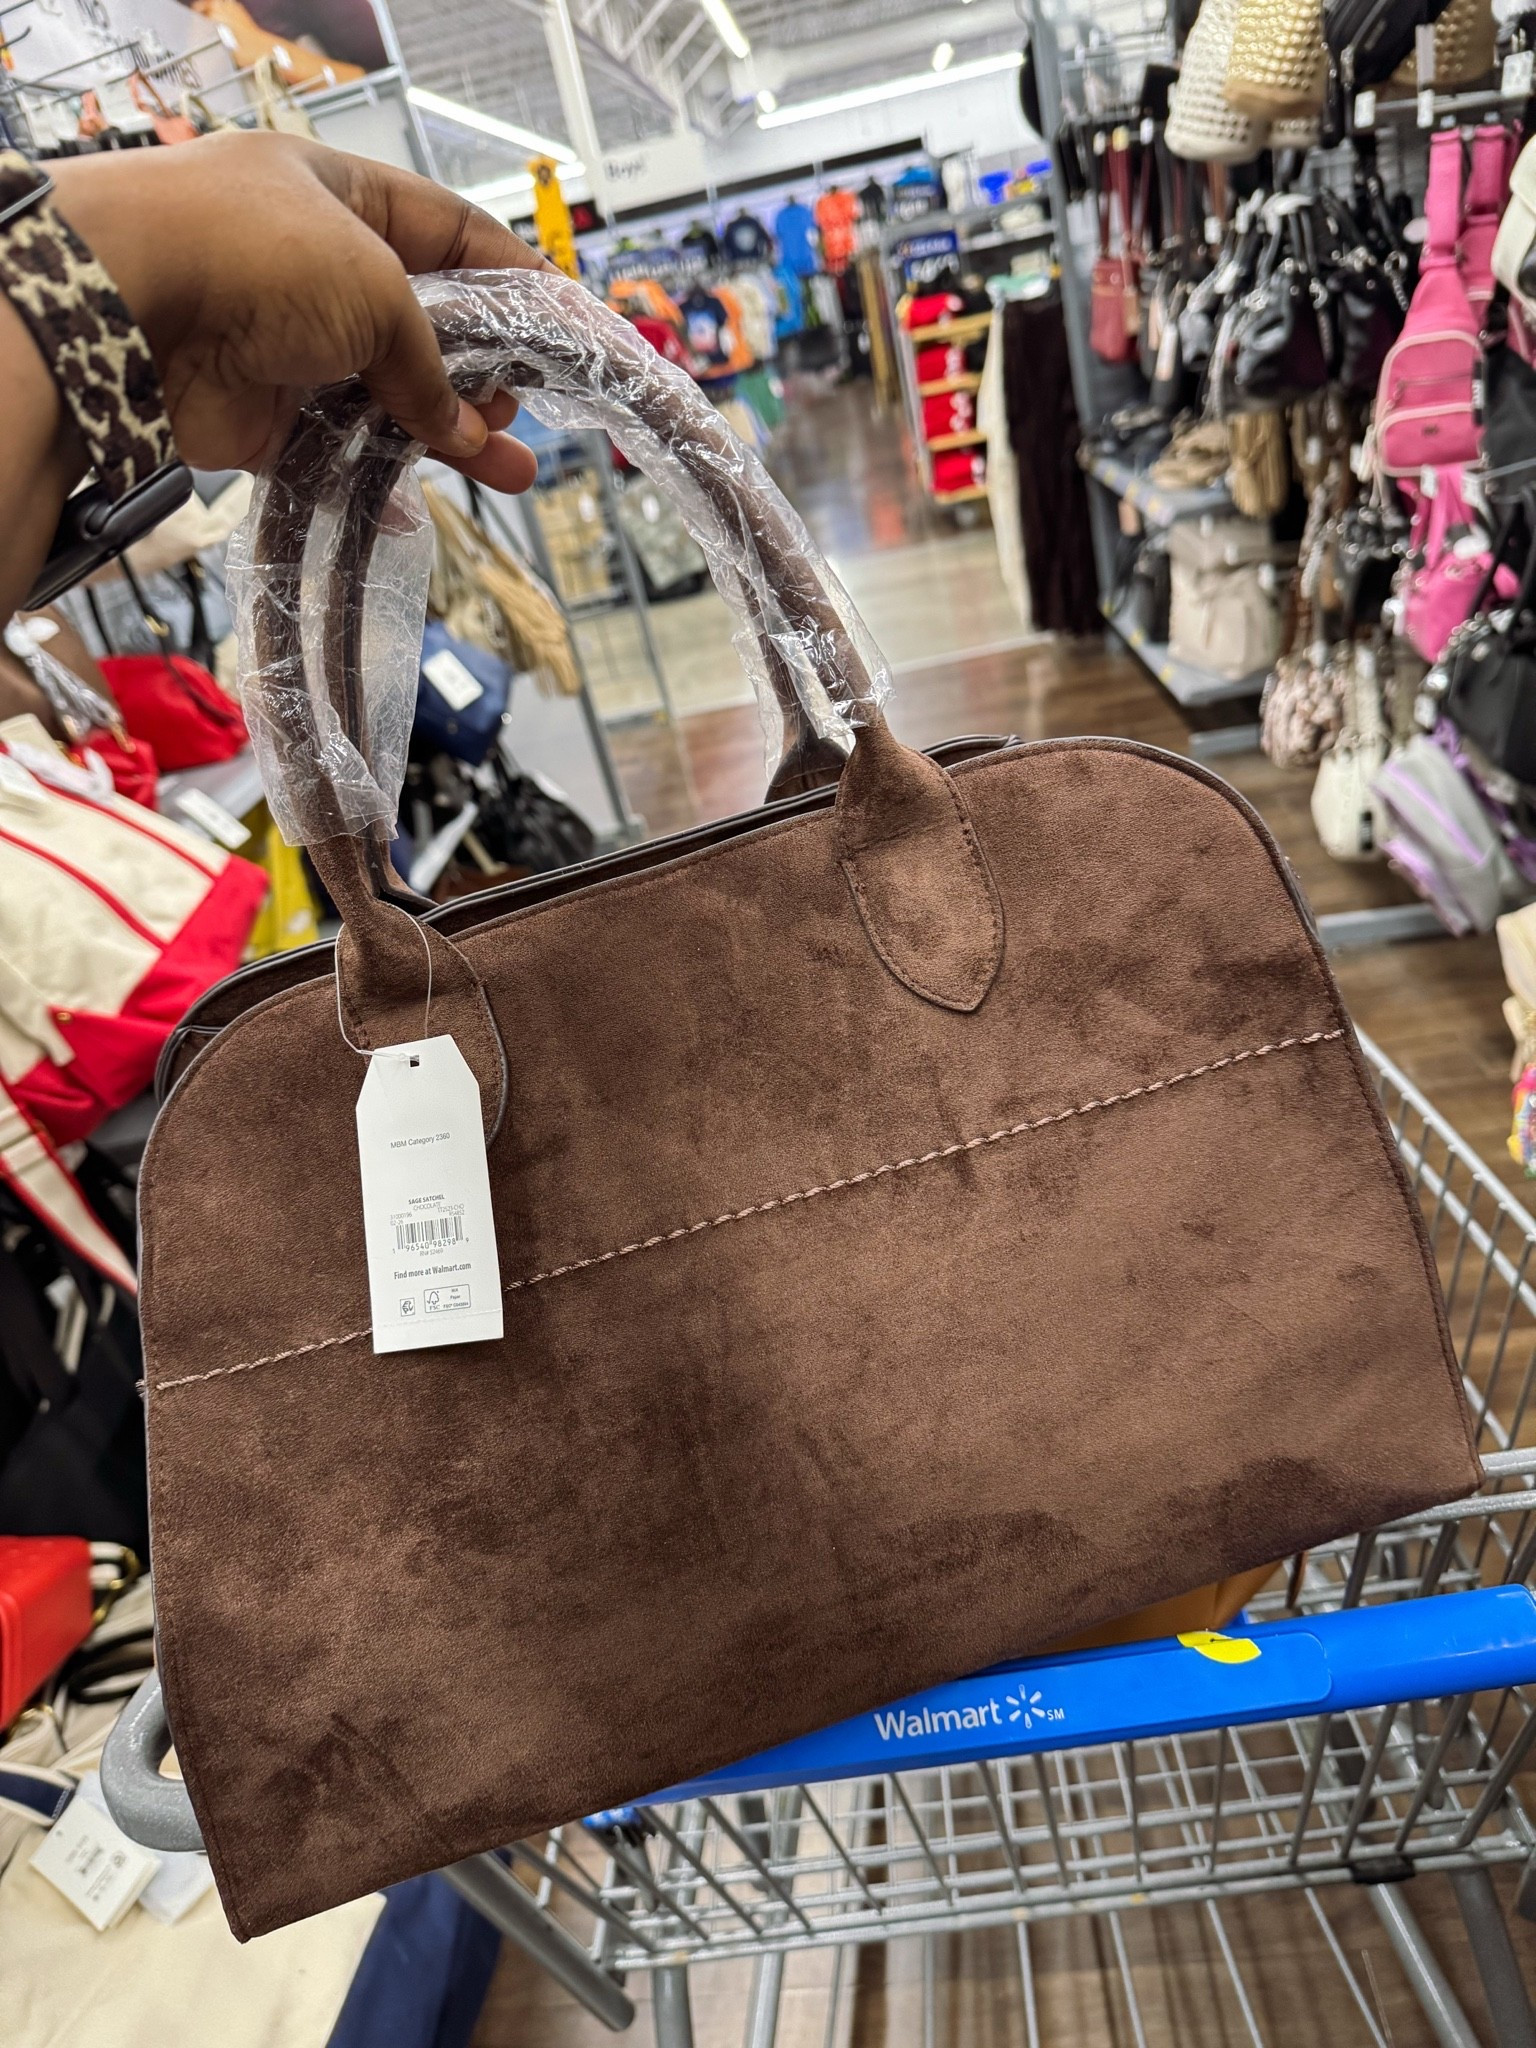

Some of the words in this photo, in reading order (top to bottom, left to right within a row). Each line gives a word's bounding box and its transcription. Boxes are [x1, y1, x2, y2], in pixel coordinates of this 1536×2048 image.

[390, 1140, 407, 1149] MBM
[408, 1135, 435, 1146] Category
[435, 1132, 451, 1141] 2360
[413, 1202, 441, 1211] CHOCOLATE
[422, 1194, 445, 1203] SATCHEL
[405, 1242, 430, 1252] 96540
[433, 1237, 456, 1248] 98298
[394, 1270, 408, 1280] Find
[408, 1269, 424, 1278] more
[425, 1267, 432, 1275] at
[432, 1262, 472, 1274] Walmart.com
[873, 1697, 1003, 1741] Walmart
[1046, 1708, 1065, 1721] SM
